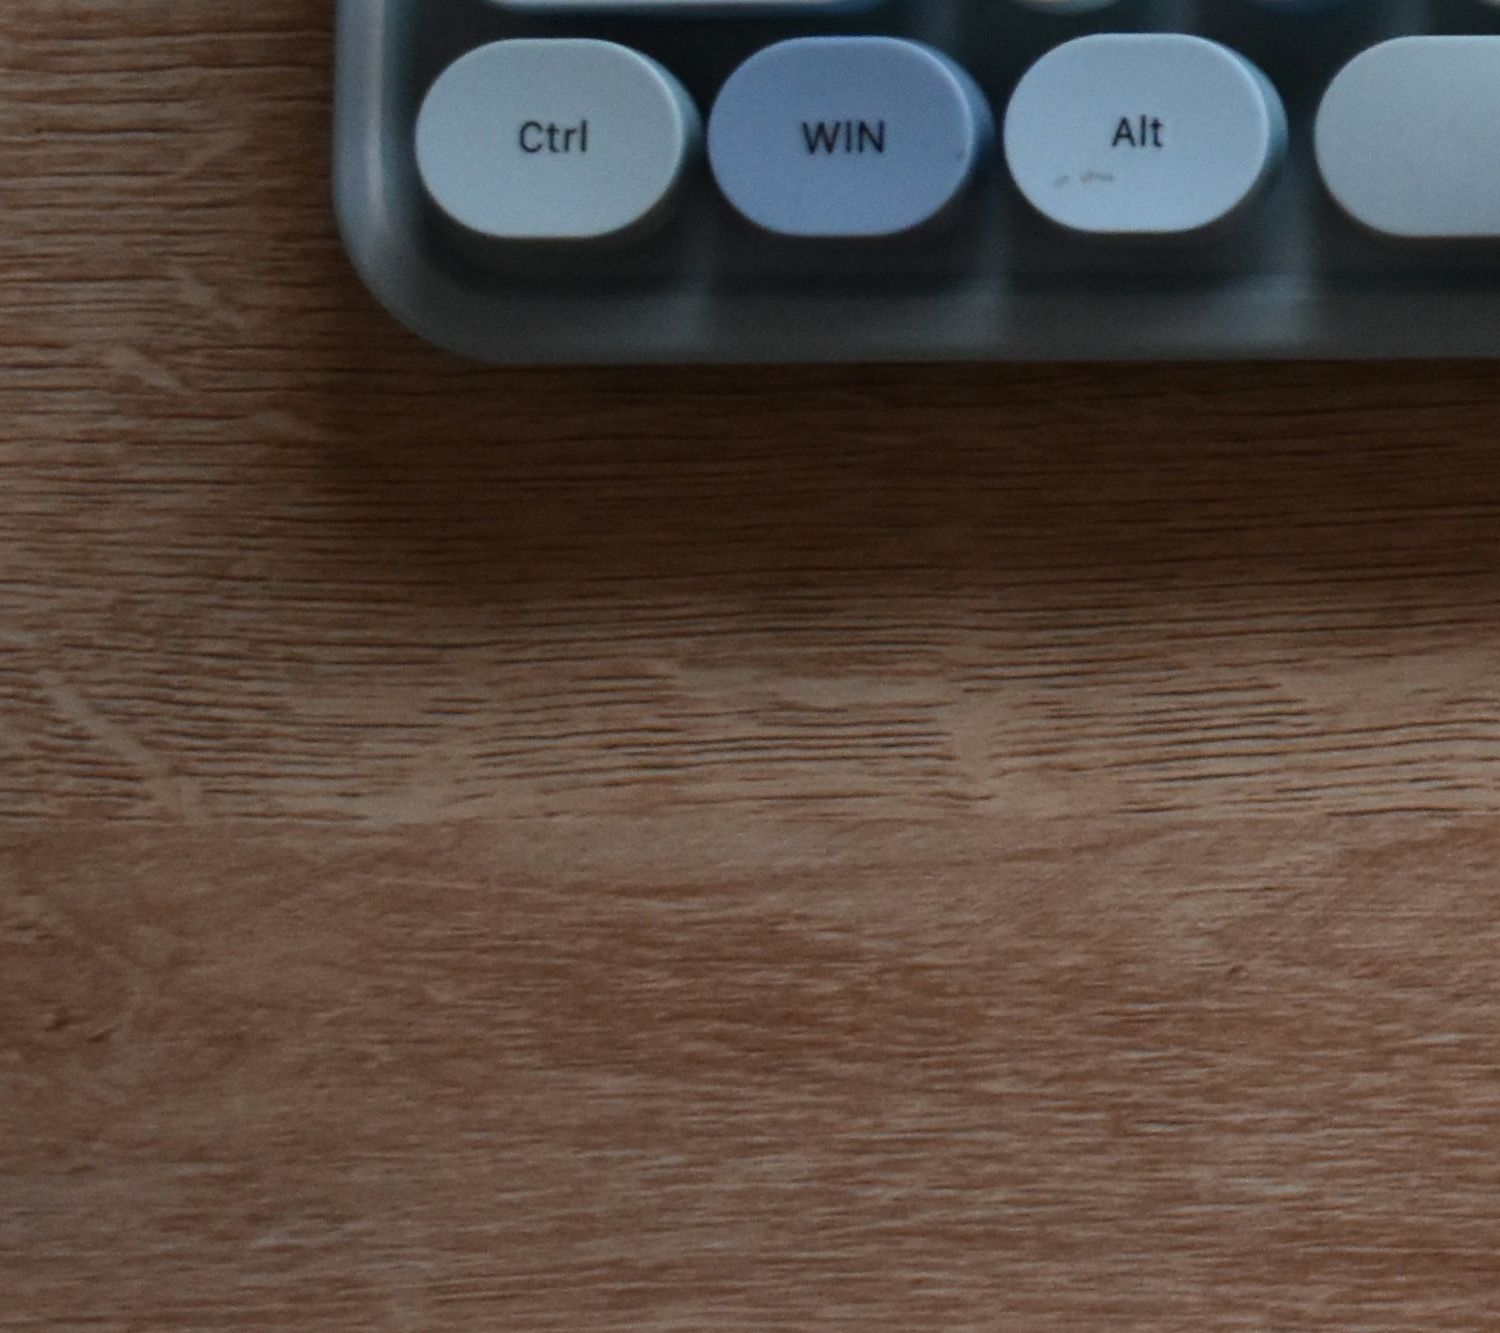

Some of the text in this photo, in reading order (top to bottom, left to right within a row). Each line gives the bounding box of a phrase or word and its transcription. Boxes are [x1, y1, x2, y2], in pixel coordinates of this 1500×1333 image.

[519, 120, 587, 153] Ctrl
[802, 121, 885, 154] WIN
[1112, 115, 1162, 148] Alt
